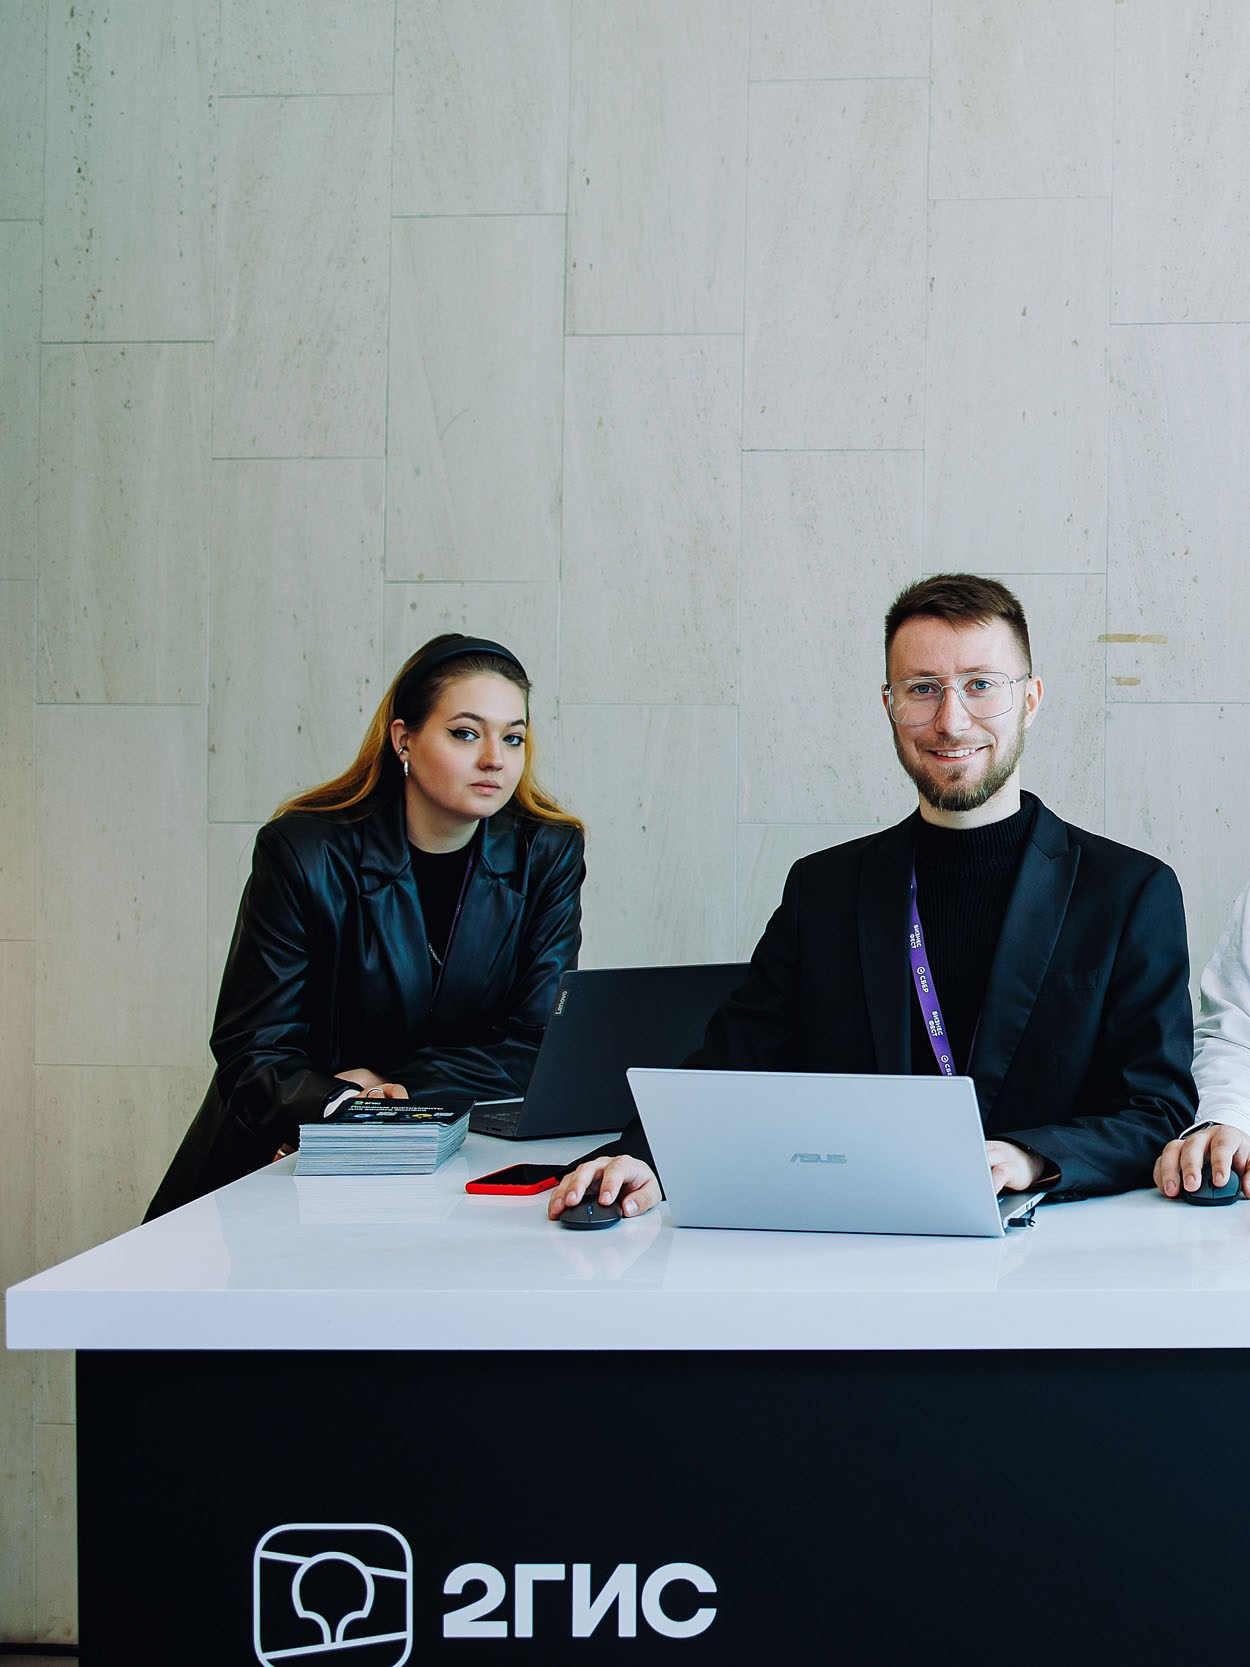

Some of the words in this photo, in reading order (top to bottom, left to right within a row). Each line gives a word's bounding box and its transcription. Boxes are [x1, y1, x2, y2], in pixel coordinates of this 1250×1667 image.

[554, 991, 568, 1015] Lenovo
[790, 1152, 848, 1164] ASUS
[442, 1562, 718, 1638] 2ГИС
